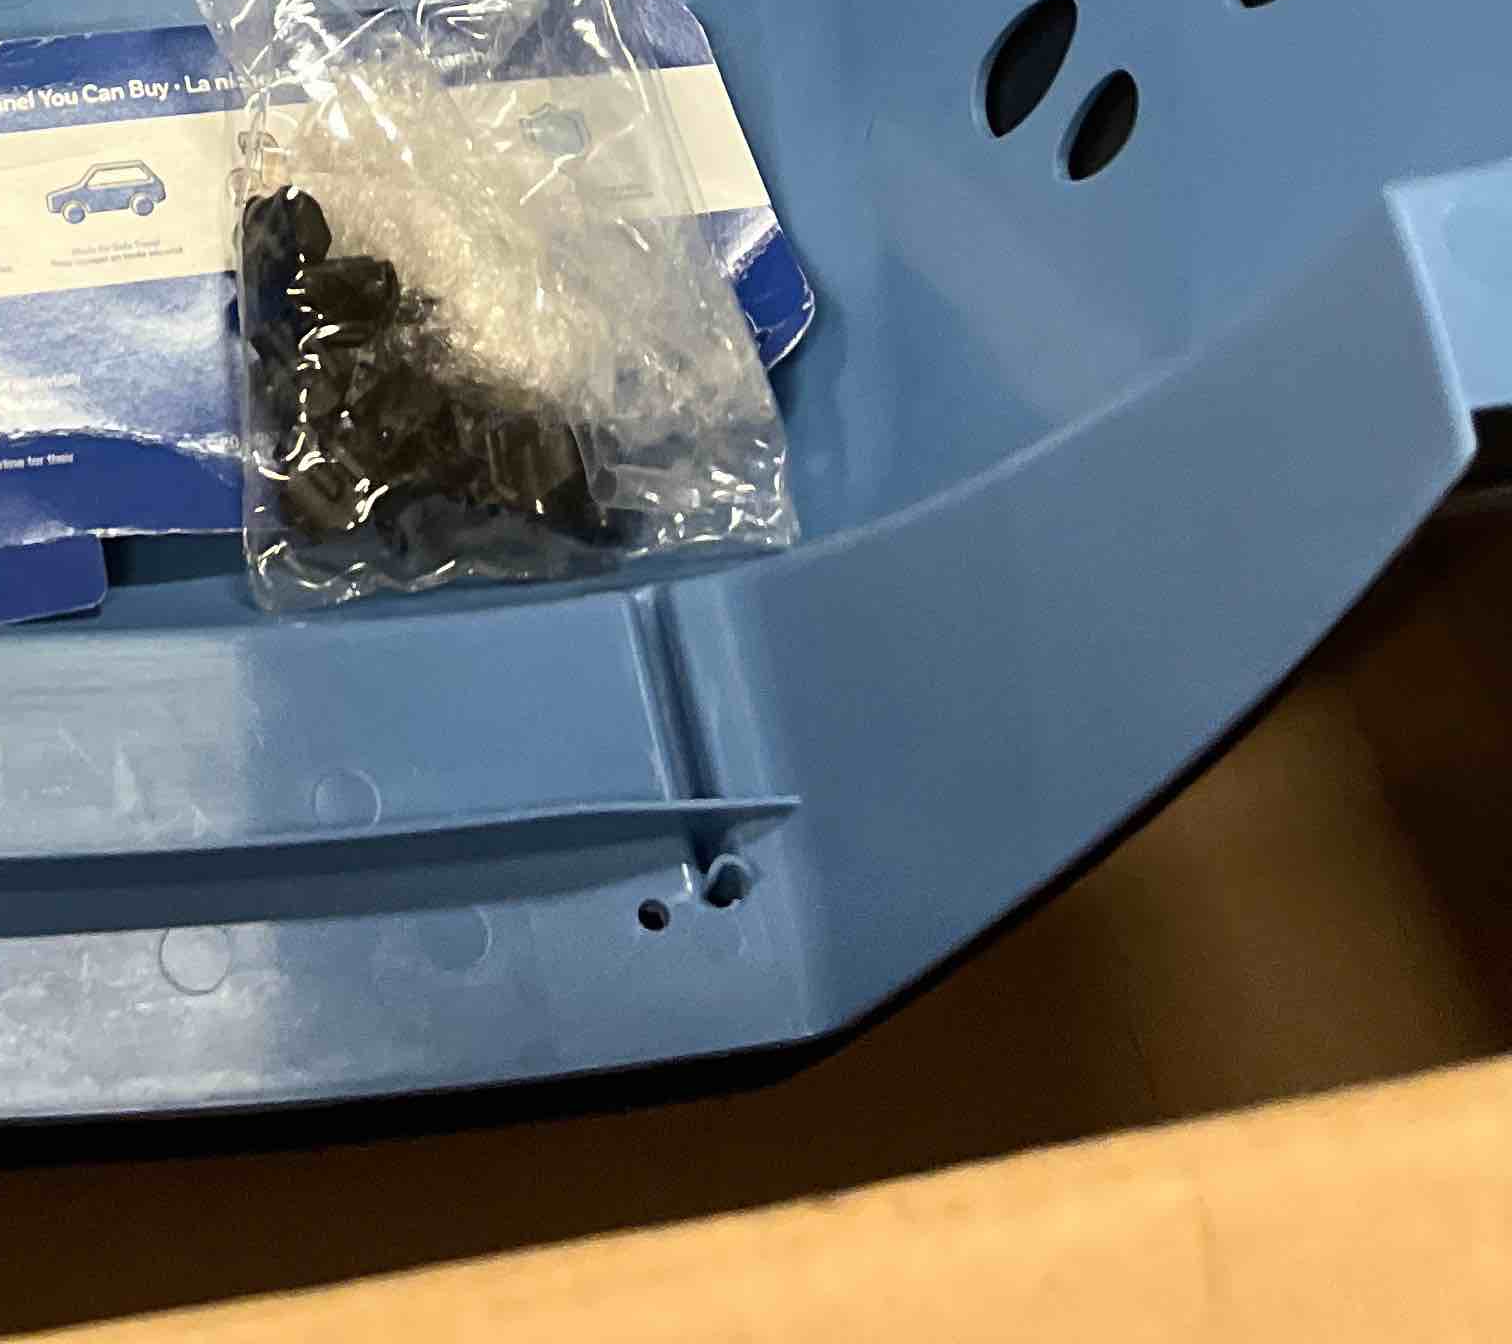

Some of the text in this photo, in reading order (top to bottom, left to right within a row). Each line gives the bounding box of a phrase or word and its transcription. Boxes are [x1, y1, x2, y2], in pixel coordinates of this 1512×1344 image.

[39, 88, 79, 108] You
[82, 83, 124, 104] Can
[128, 78, 169, 102] Buy
[184, 74, 211, 94] La
